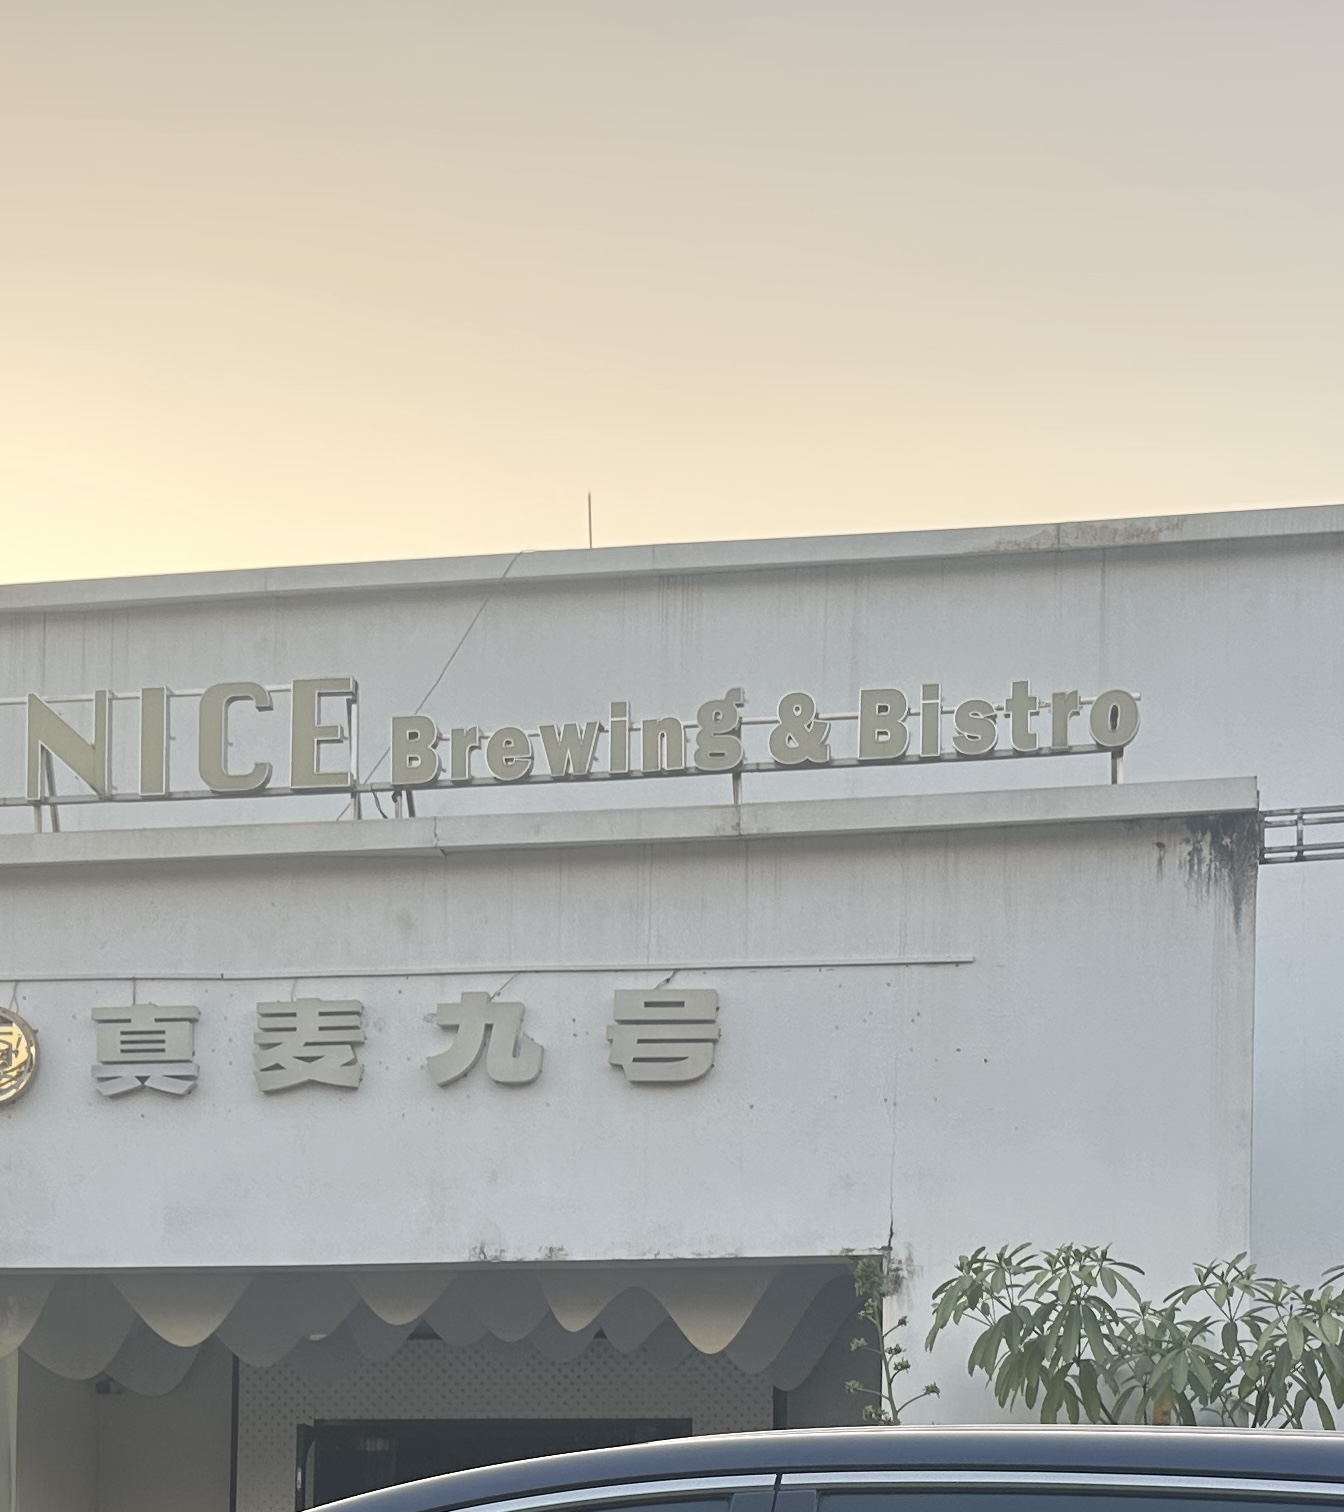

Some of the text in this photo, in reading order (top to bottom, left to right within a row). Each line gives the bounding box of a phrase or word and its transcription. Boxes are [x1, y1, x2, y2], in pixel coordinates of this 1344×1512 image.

[27, 677, 358, 799] NICE
[390, 687, 745, 785] Brewing
[768, 690, 830, 764] &
[859, 681, 1140, 761] Bistro
[91, 988, 722, 1098] 真麦九号
